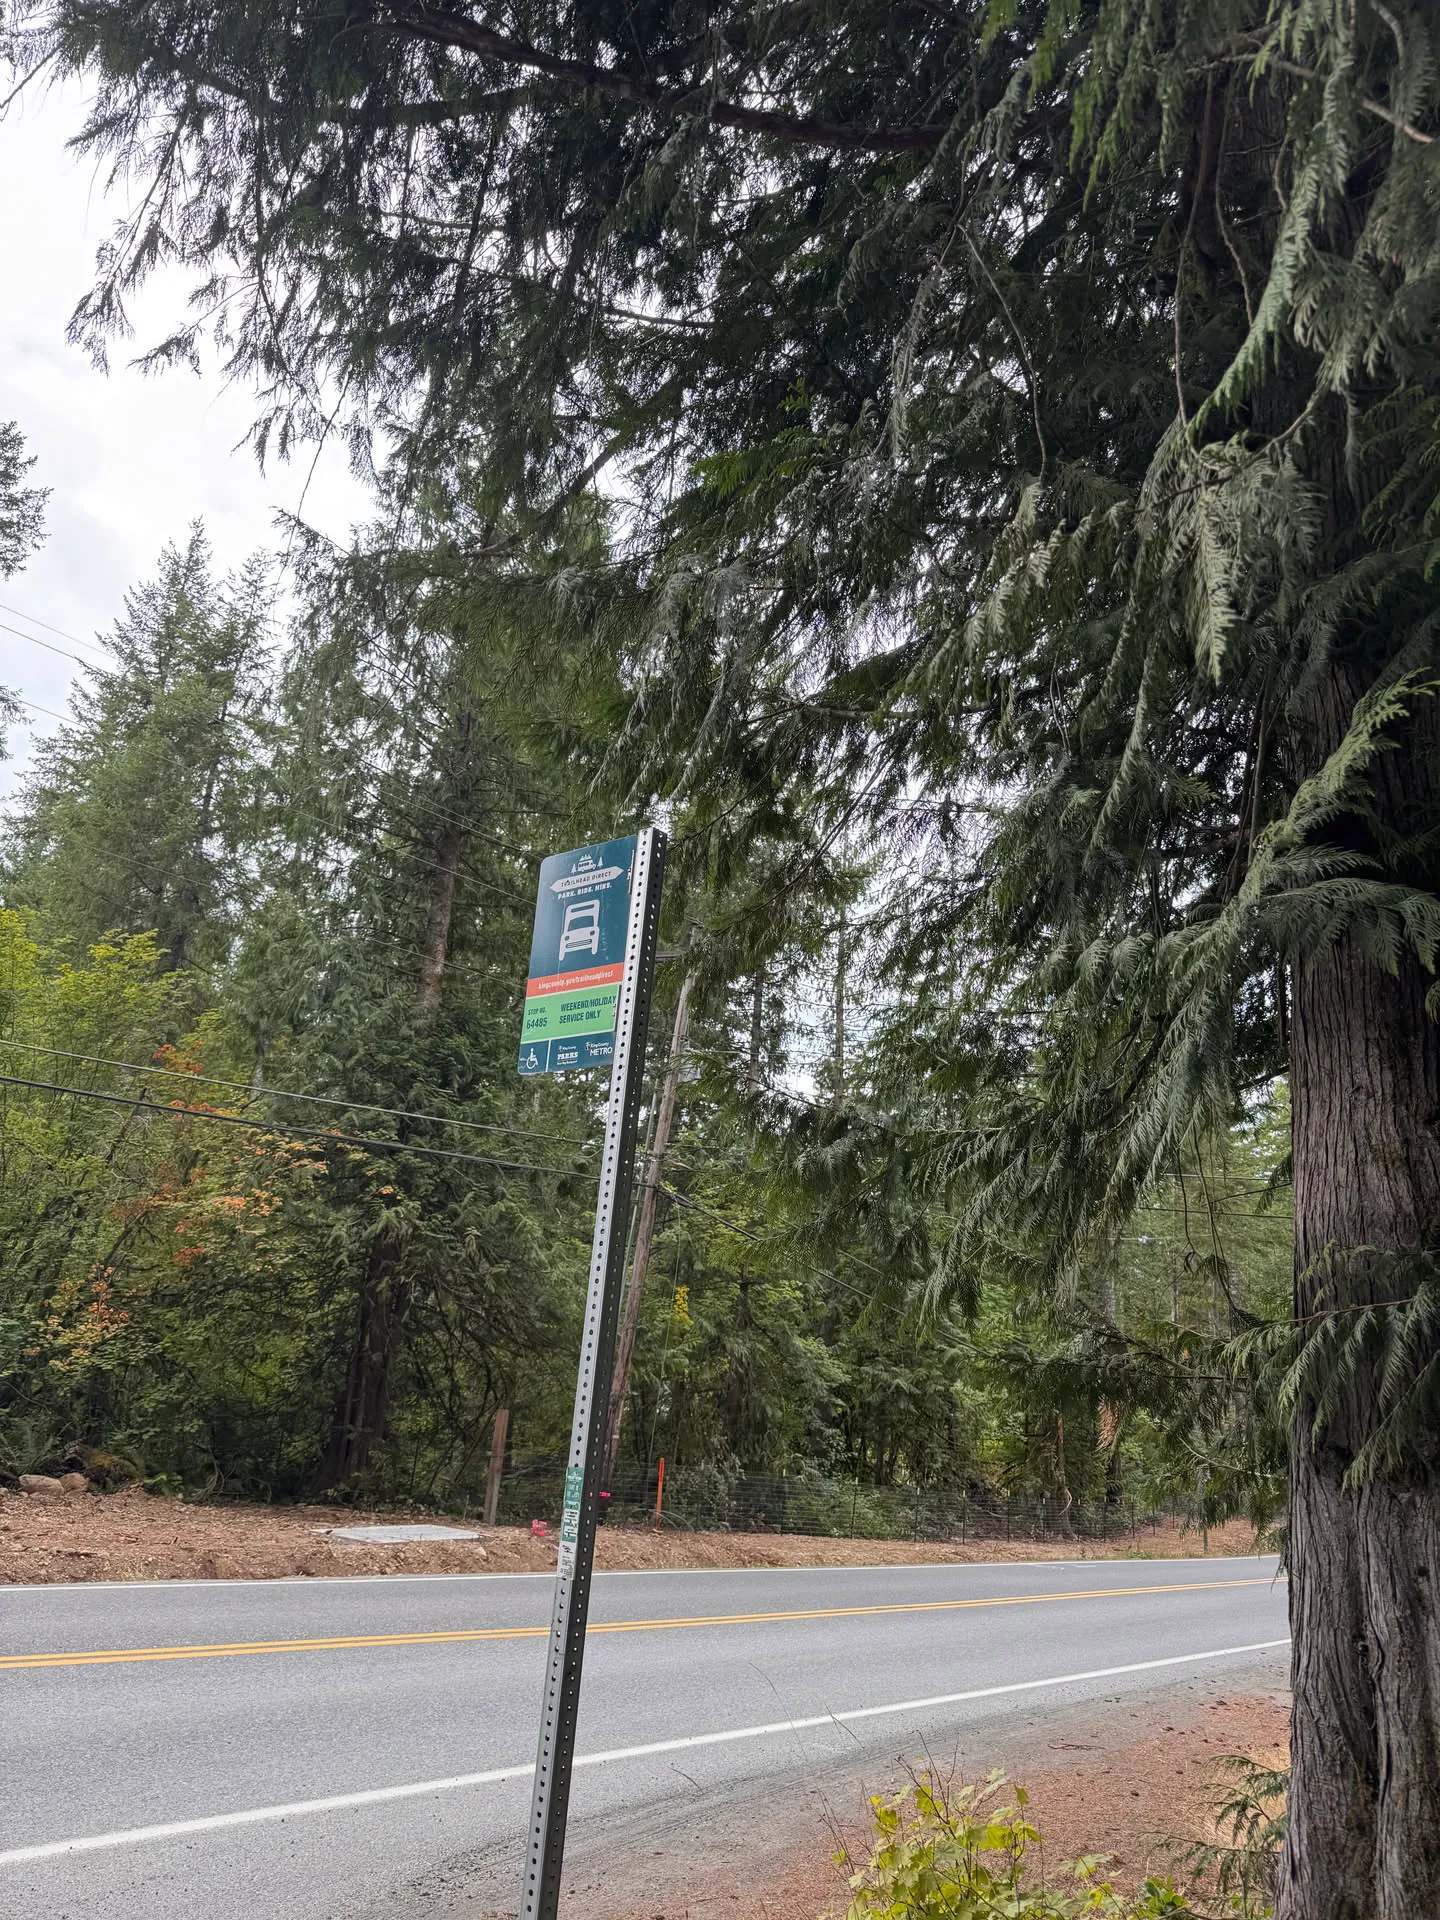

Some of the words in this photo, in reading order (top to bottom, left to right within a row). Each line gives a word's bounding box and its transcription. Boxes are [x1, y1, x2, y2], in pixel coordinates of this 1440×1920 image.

[561, 876, 590, 887] TRAILHEAD
[592, 871, 612, 880] DIRECT
[557, 891, 576, 900] PARK.
[577, 887, 594, 896] RIDE.
[595, 882, 612, 892] HIKE.
[538, 970, 613, 990] kingcounty.gov/trailheaddirect
[560, 995, 617, 1012] WEEKEND/HOLIDAY
[526, 1017, 548, 1029] 64485
[559, 1013, 584, 1024] SERVICE
[585, 1010, 602, 1020] ONLY
[557, 1051, 579, 1060] PARKS
[590, 1046, 613, 1056] METRO
